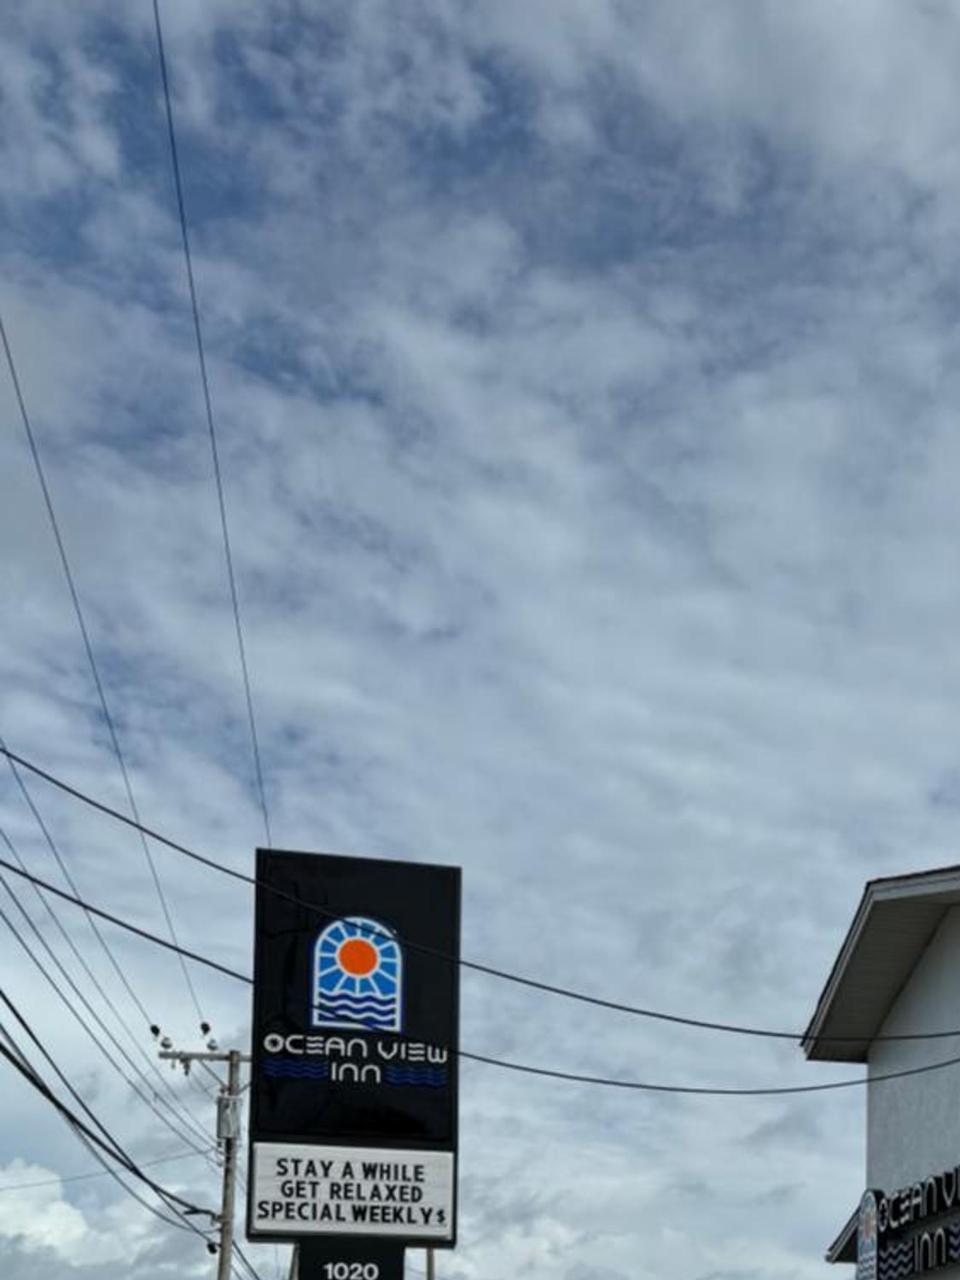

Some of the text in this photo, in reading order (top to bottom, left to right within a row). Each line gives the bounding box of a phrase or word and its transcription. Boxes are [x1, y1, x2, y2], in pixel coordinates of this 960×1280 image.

[263, 1033, 448, 1064] OCEAN VIEW
[331, 1061, 381, 1083] INN
[276, 1158, 425, 1183] STAY A WHILE
[280, 1180, 423, 1203] GET RELAXED
[878, 1175, 938, 1232] OCEAN
[257, 1200, 346, 1222] SPECIAL
[914, 1228, 946, 1272] INN
[323, 1262, 379, 1280] 1020
